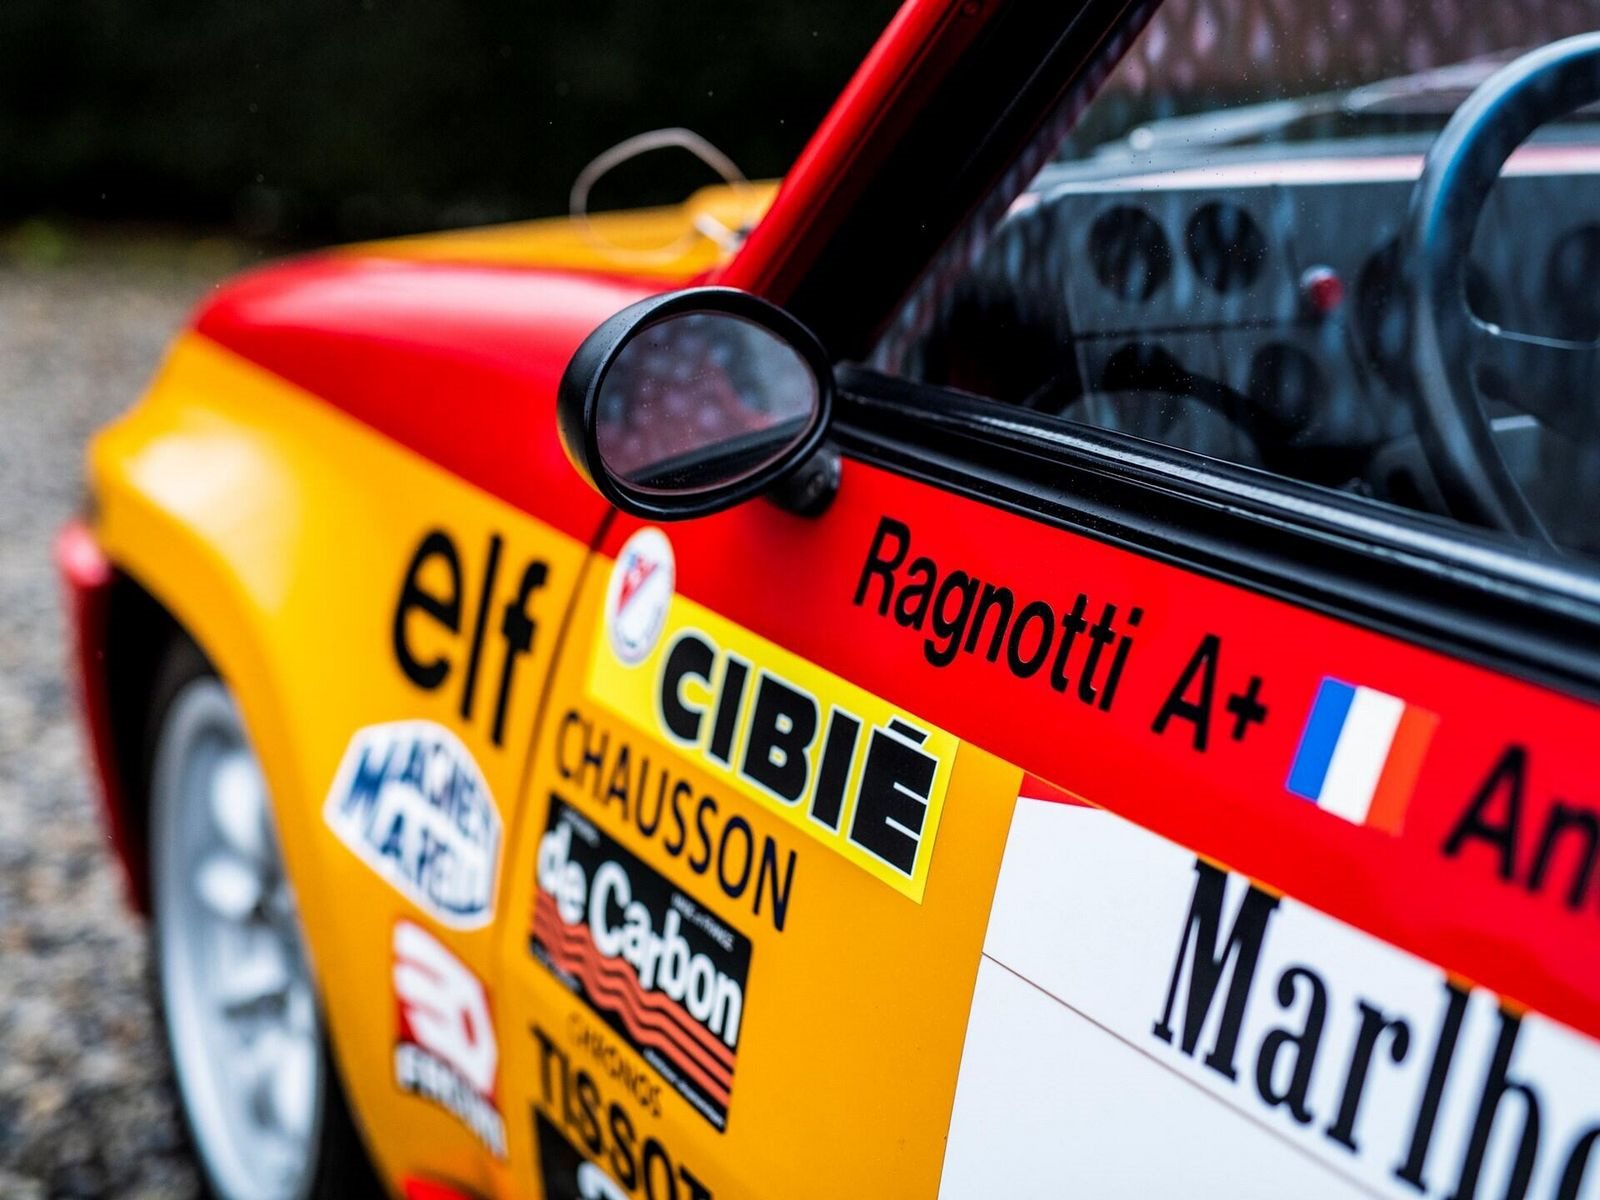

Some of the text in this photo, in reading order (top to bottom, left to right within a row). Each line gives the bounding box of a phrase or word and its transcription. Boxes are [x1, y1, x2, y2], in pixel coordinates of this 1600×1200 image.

[393, 529, 549, 748] elf
[853, 515, 1144, 712] Ragnotti
[1151, 633, 1268, 754] A+
[556, 710, 798, 932] CHAUSSON
[660, 634, 938, 878] CIBIÉ
[1442, 746, 1600, 908] An
[537, 821, 587, 925] de
[589, 861, 743, 1047] Carbon
